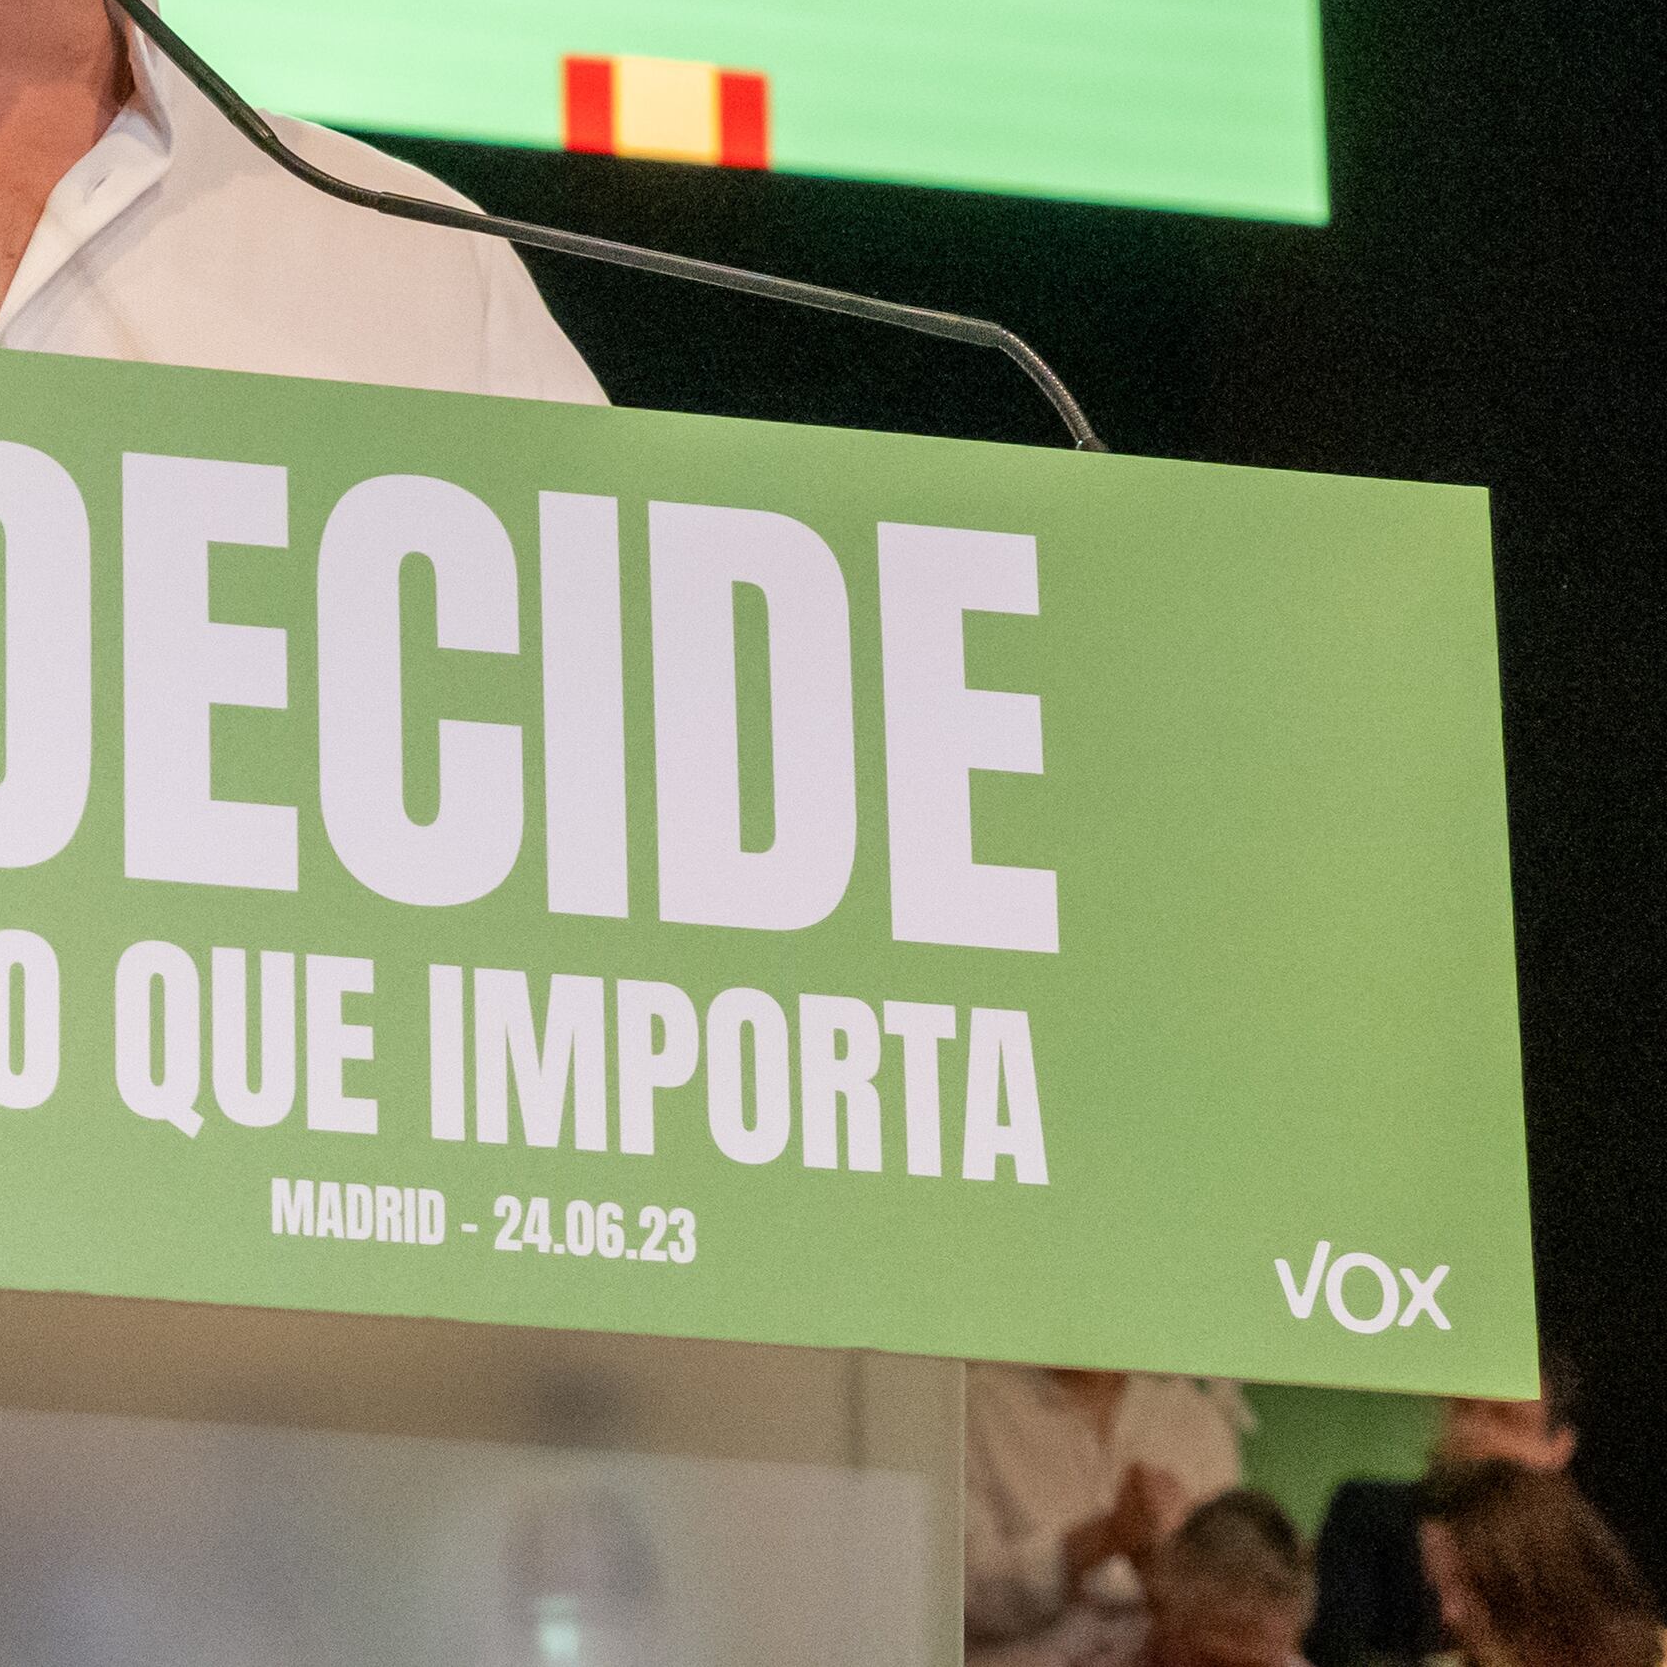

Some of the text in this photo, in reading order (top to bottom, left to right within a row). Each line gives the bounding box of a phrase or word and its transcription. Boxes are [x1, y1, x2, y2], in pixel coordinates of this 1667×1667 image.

[114, 940, 378, 1138] QUE
[428, 963, 1049, 1186] IMPORTA
[271, 1177, 445, 1245] MADRID
[493, 1194, 697, 1264] 24.06.23
[1274, 1240, 1452, 1334] VOX
